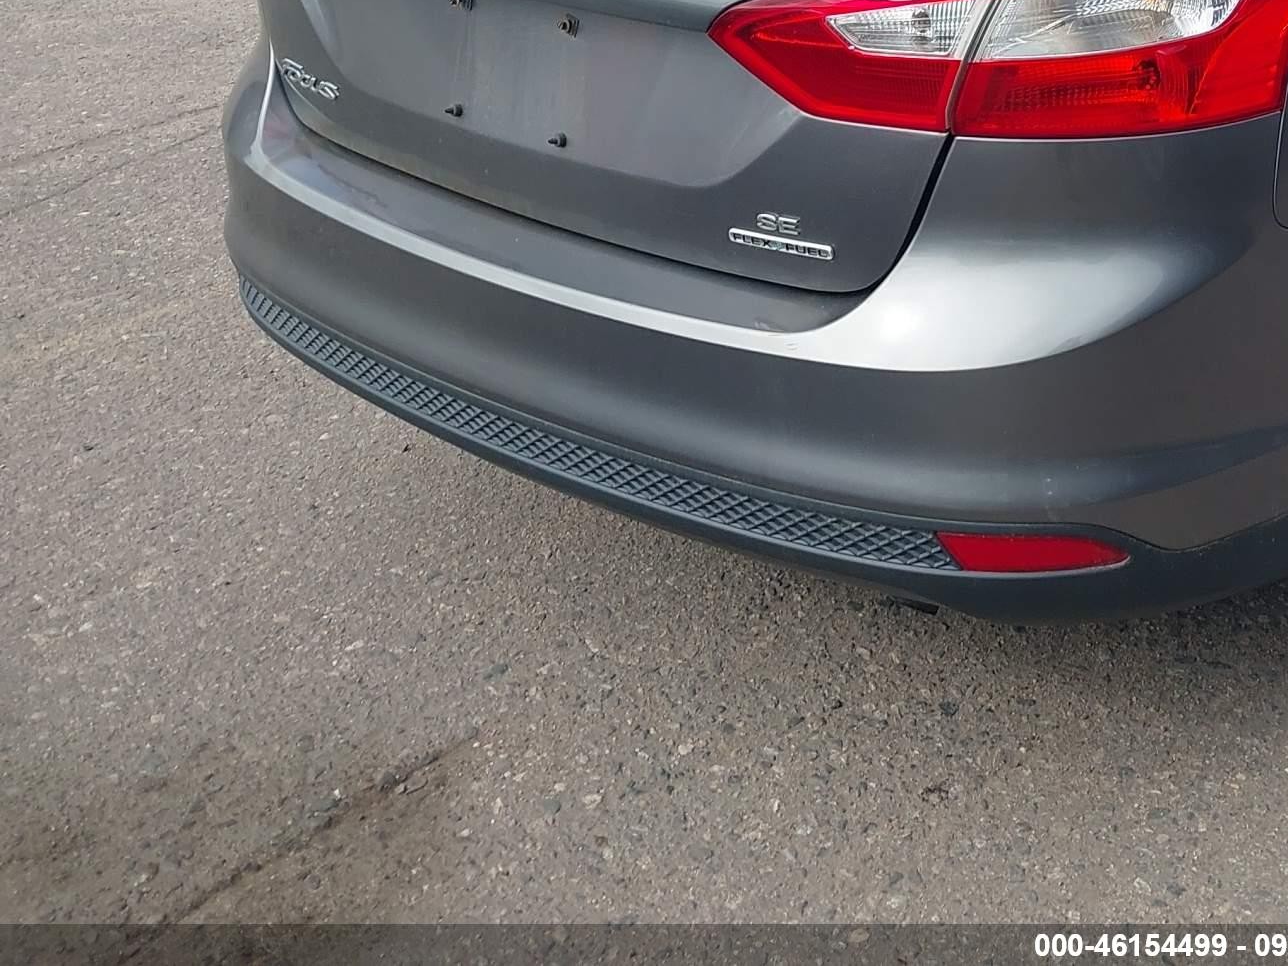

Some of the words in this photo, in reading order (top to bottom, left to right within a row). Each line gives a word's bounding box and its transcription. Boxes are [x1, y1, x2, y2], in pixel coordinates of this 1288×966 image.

[756, 211, 801, 236] SE
[731, 232, 772, 247] FLEX
[785, 243, 830, 259] FUEL
